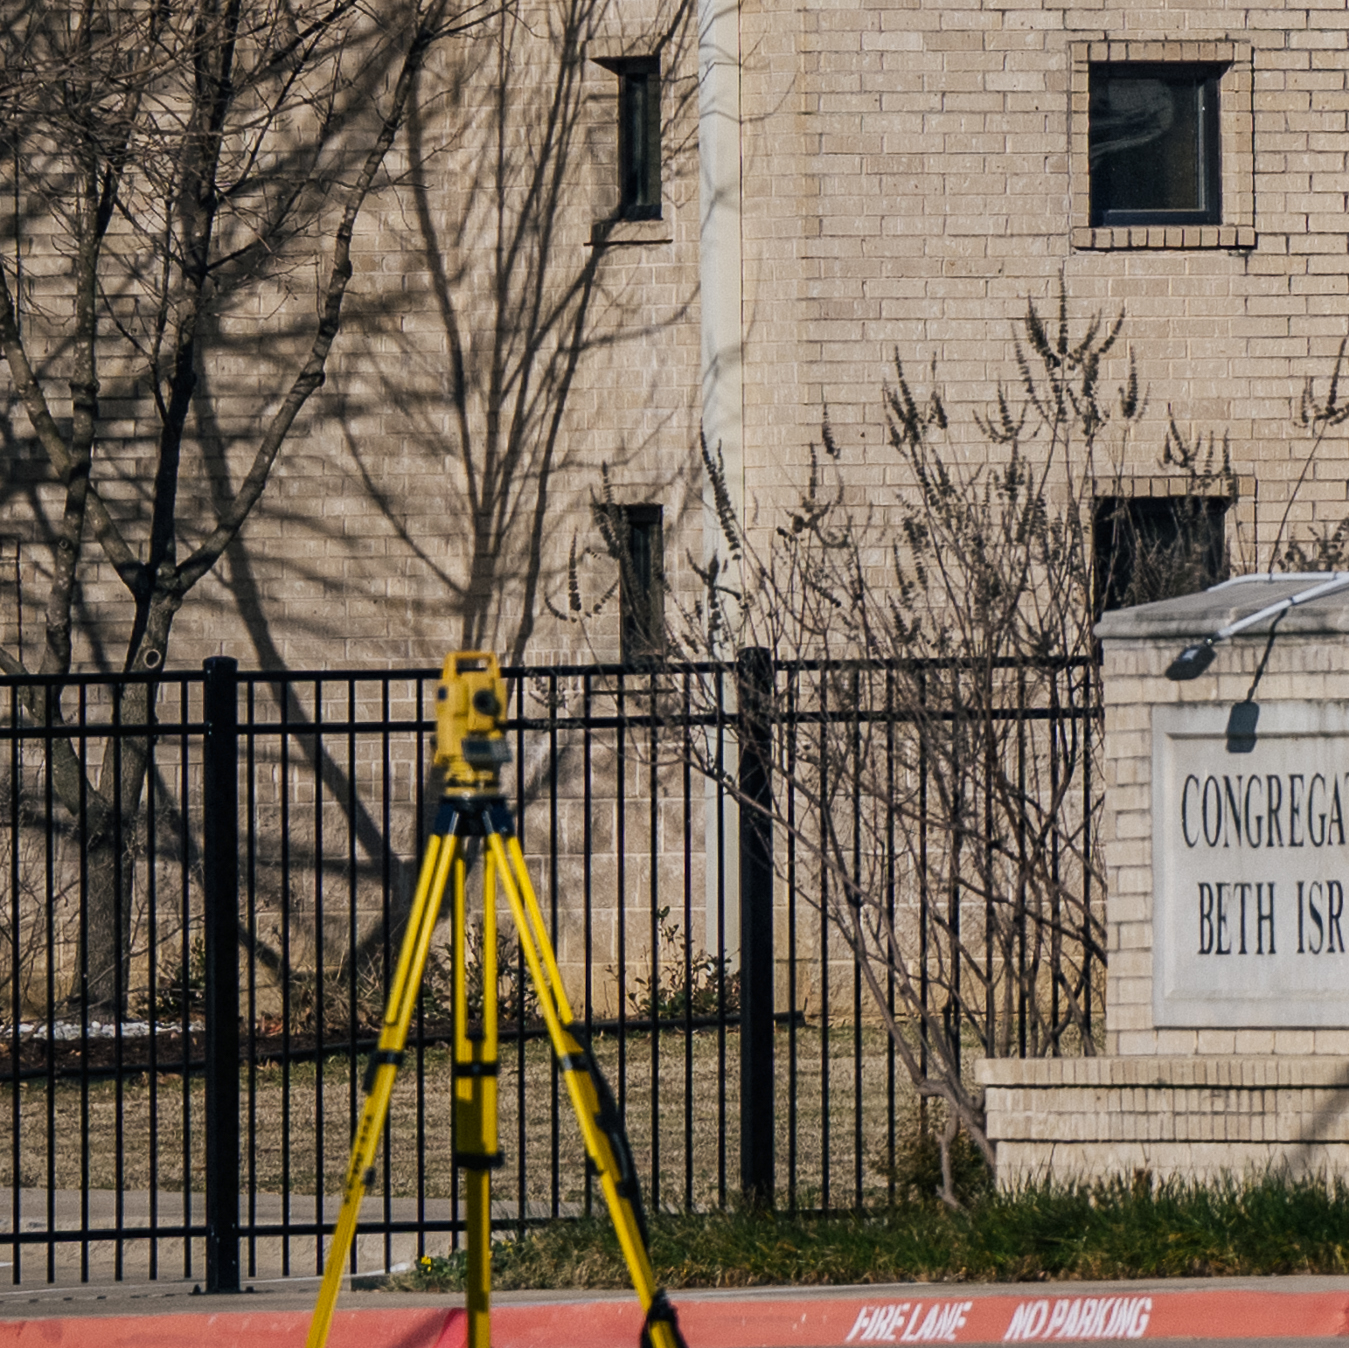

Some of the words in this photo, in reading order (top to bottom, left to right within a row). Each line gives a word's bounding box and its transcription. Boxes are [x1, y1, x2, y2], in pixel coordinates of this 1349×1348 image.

[1197, 881, 1277, 956] BETH
[844, 1302, 911, 1342] FIRE
[899, 1300, 974, 1342] LANE
[1002, 1299, 1050, 1342] NO
[1041, 1296, 1153, 1340] PARKING
